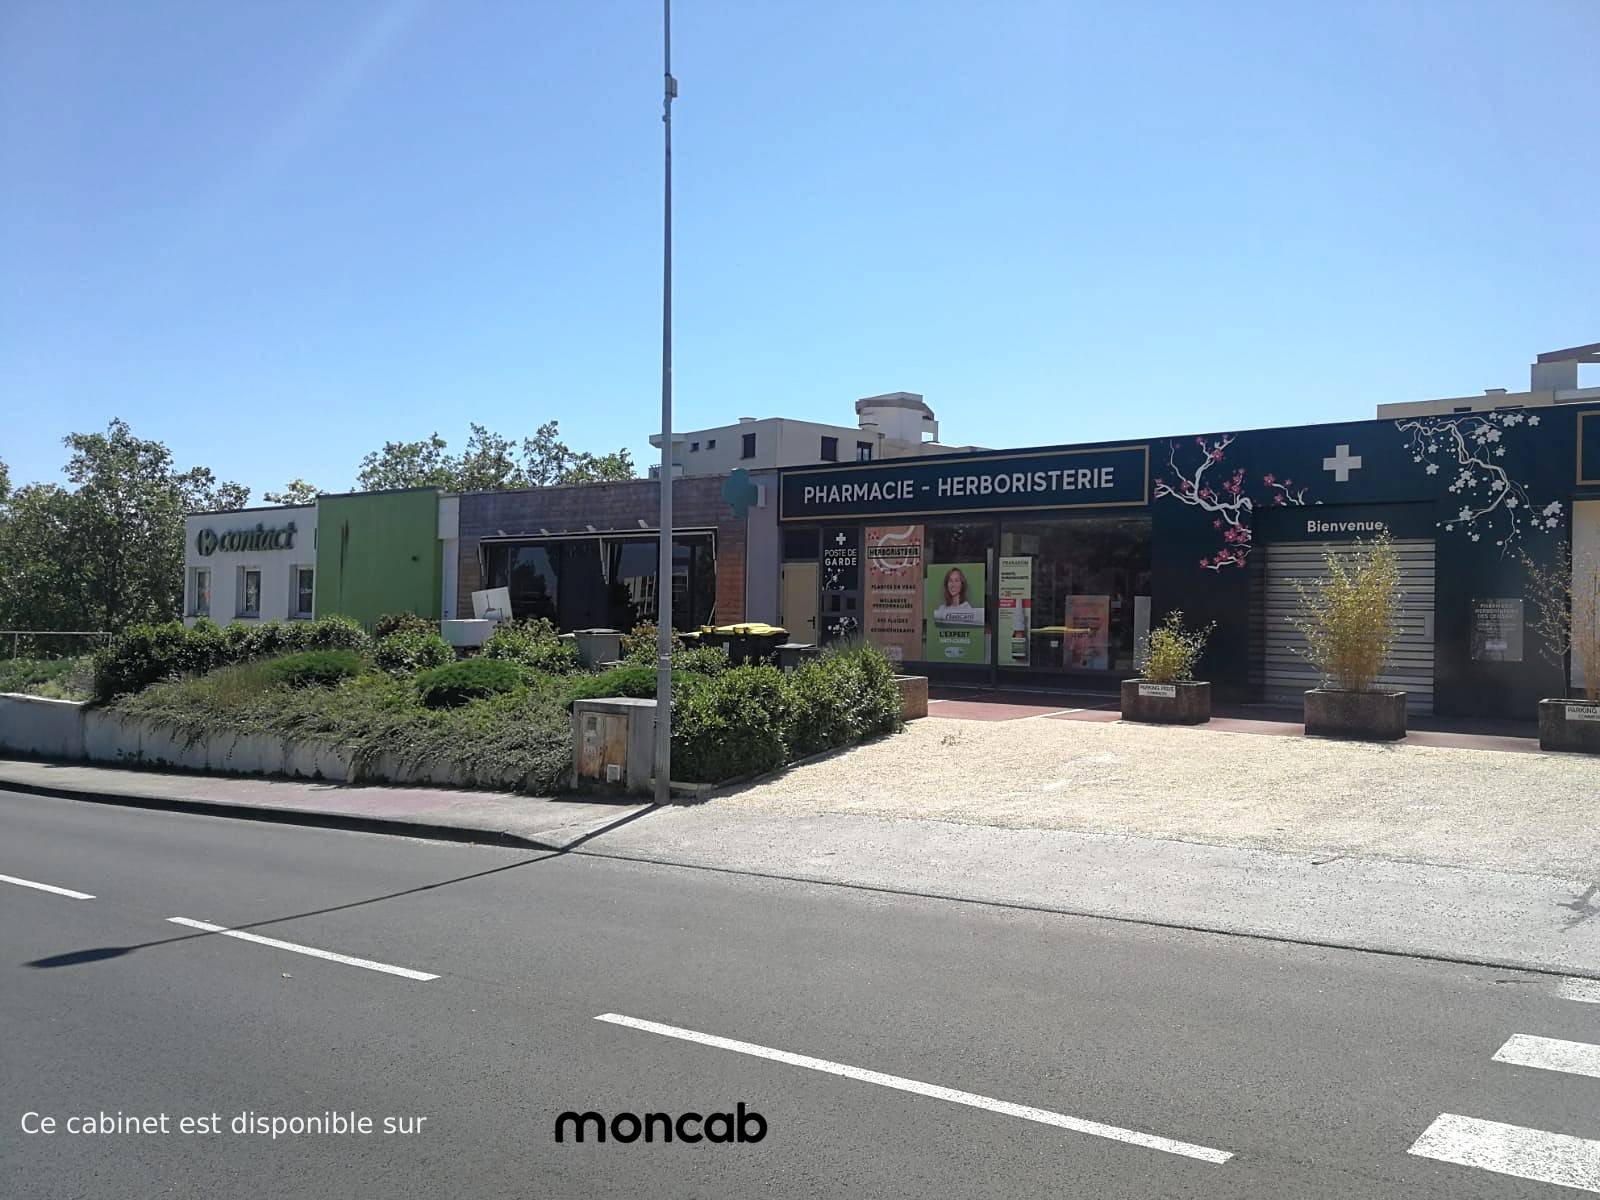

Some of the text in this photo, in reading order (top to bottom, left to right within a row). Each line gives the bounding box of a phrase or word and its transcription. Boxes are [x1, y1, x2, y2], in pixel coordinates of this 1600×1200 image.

[803, 479, 914, 504] PHARMACIE
[938, 467, 1114, 497] HERBORISTERIE
[1307, 520, 1384, 532] Bienvenue
[219, 521, 298, 552] contact
[824, 549, 857, 557] POSTE DE
[869, 547, 919, 556] HERBORISTERIE
[824, 557, 857, 566] GARDE
[939, 630, 971, 638] L'EXPERT
[1568, 706, 1598, 714] PARKING
